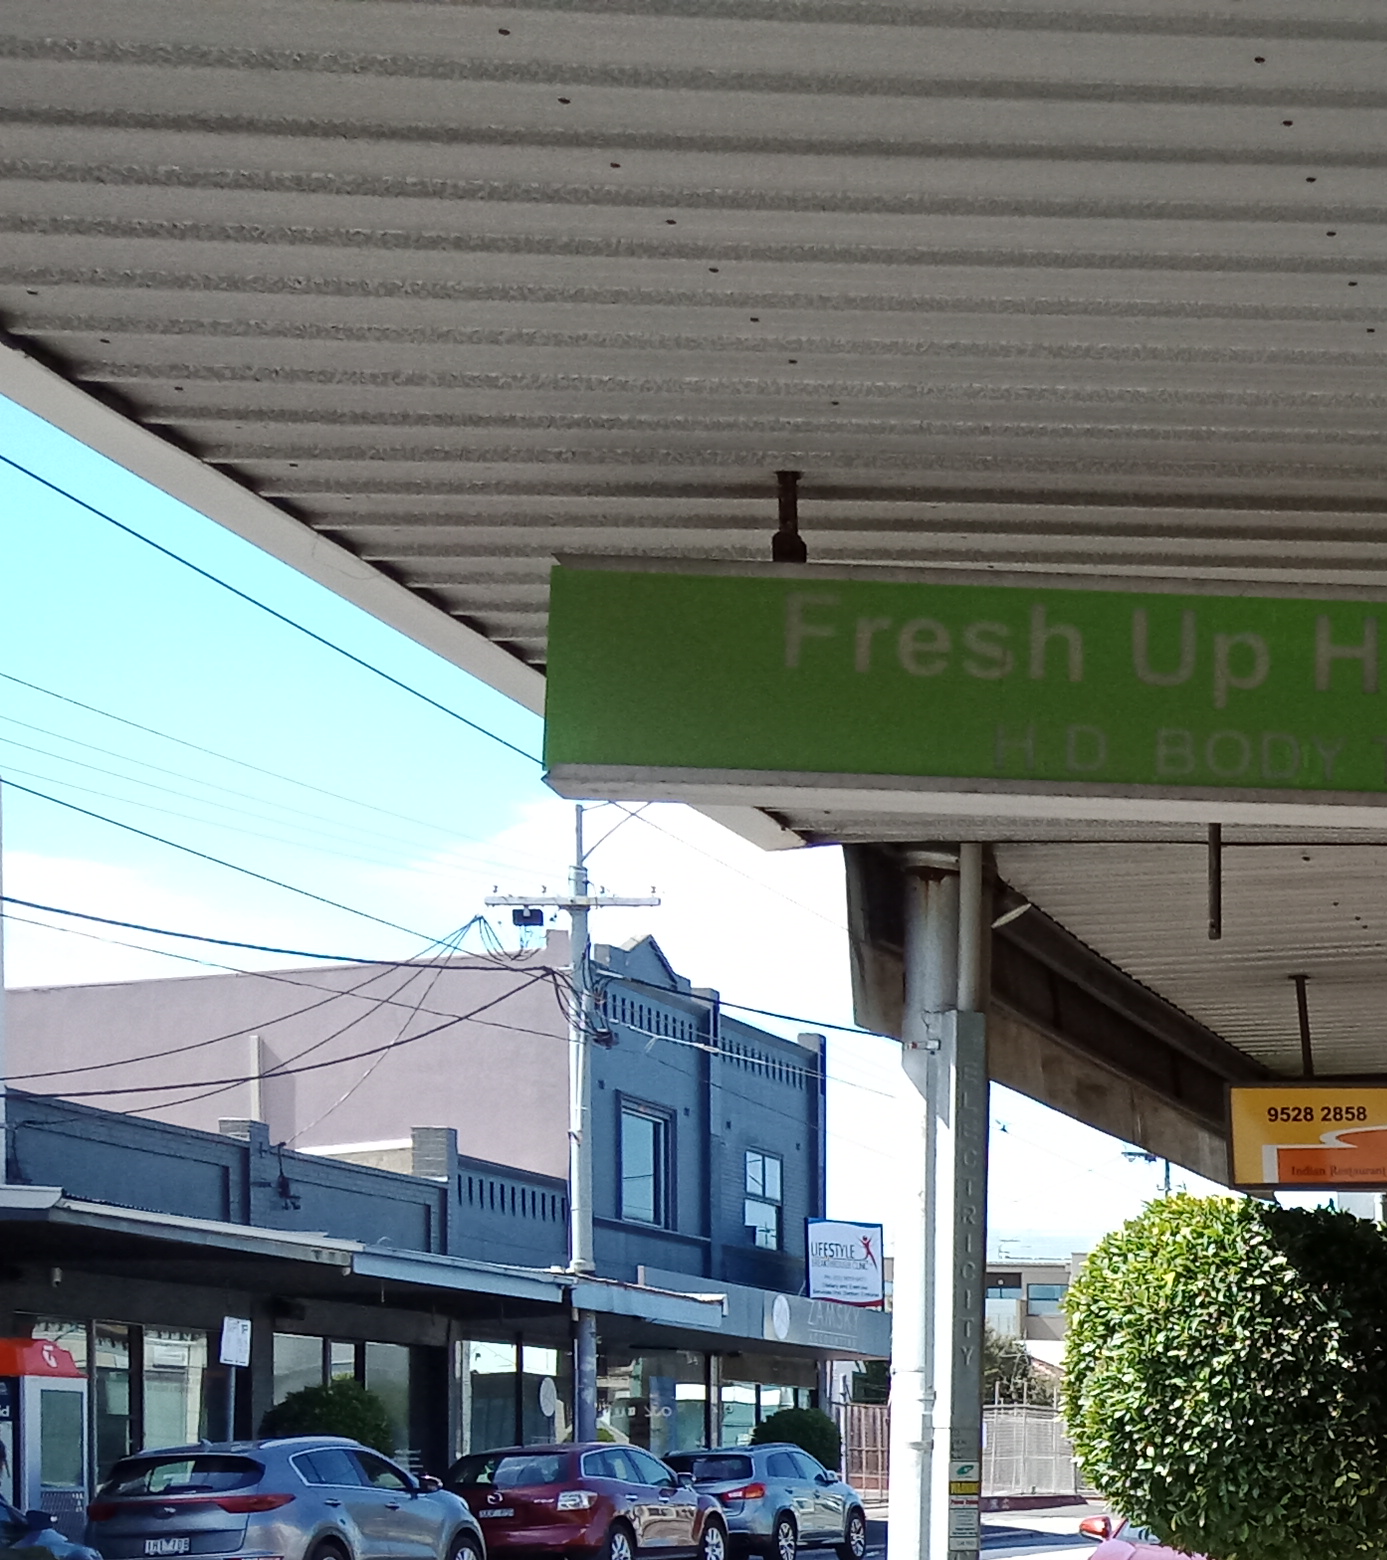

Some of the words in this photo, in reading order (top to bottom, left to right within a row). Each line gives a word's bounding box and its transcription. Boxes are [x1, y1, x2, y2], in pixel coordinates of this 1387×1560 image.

[783, 592, 1085, 684] Fresh
[1131, 607, 1271, 709] Up
[1267, 1106, 1315, 1122] 9528
[1320, 1105, 1368, 1122] 2858
[1291, 1165, 1326, 1176] Indian
